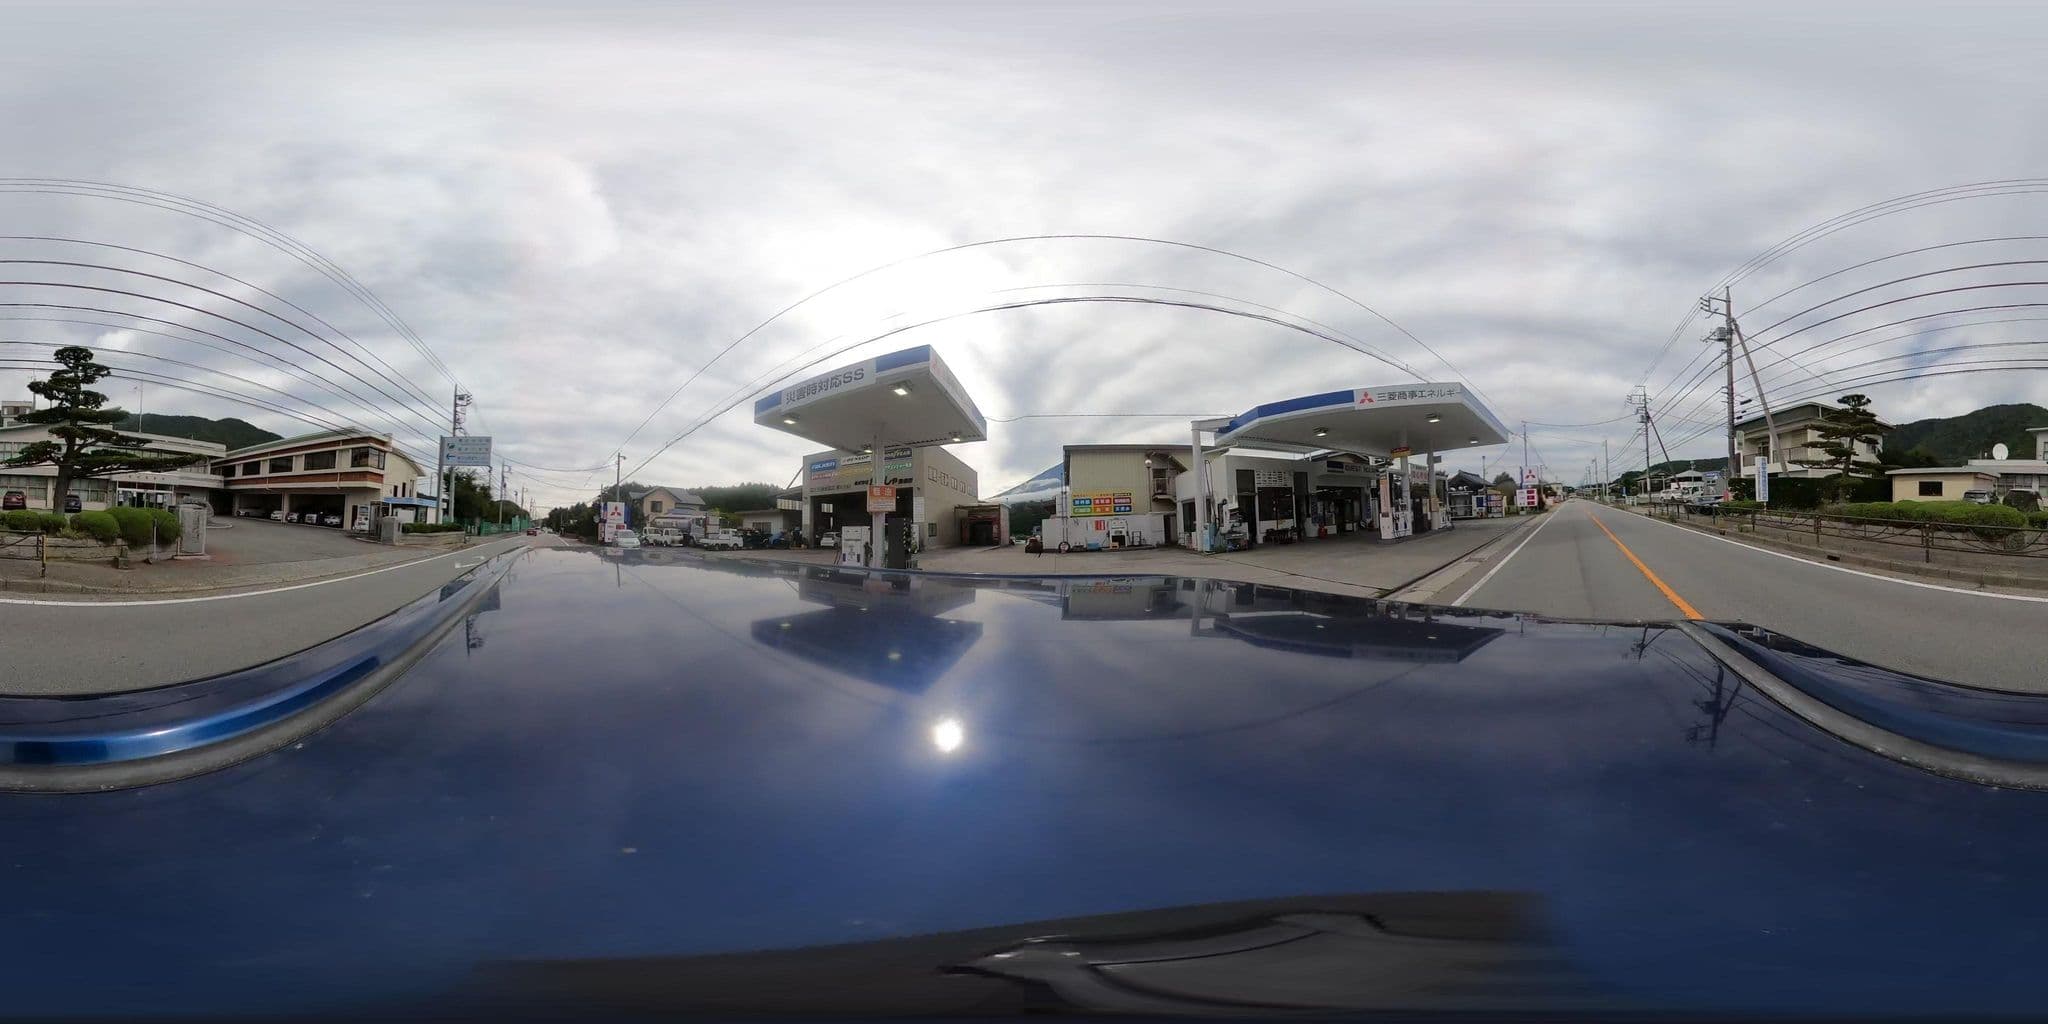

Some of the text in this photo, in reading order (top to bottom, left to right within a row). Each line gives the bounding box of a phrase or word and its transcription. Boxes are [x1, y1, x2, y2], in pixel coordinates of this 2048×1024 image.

[786, 367, 865, 405] 災害時対応SS
